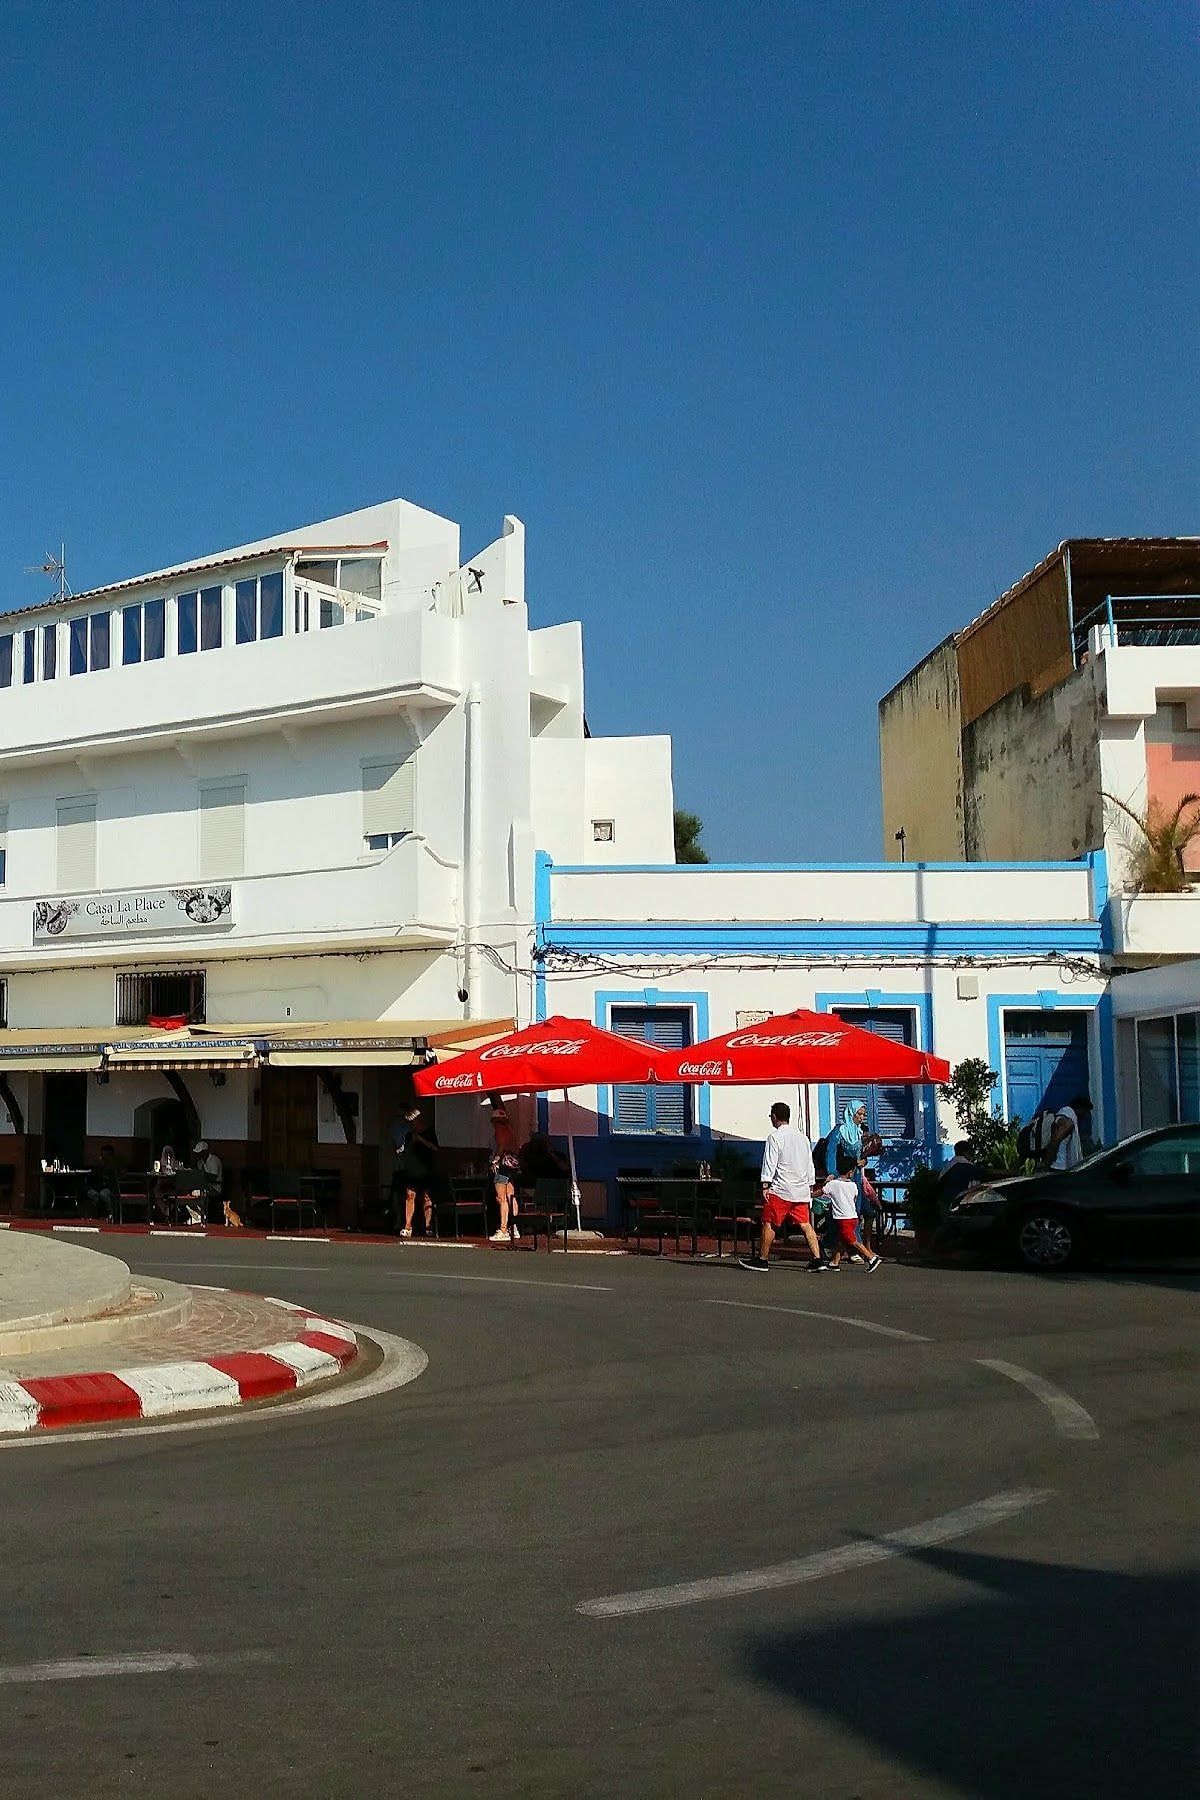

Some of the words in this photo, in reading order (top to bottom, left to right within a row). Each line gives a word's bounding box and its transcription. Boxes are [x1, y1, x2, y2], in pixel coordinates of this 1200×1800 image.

[86, 902, 113, 915] Casa
[117, 900, 131, 912] La
[135, 898, 166, 911] Place
[100, 914, 124, 926] الساحة
[125, 914, 148, 928] مطعم
